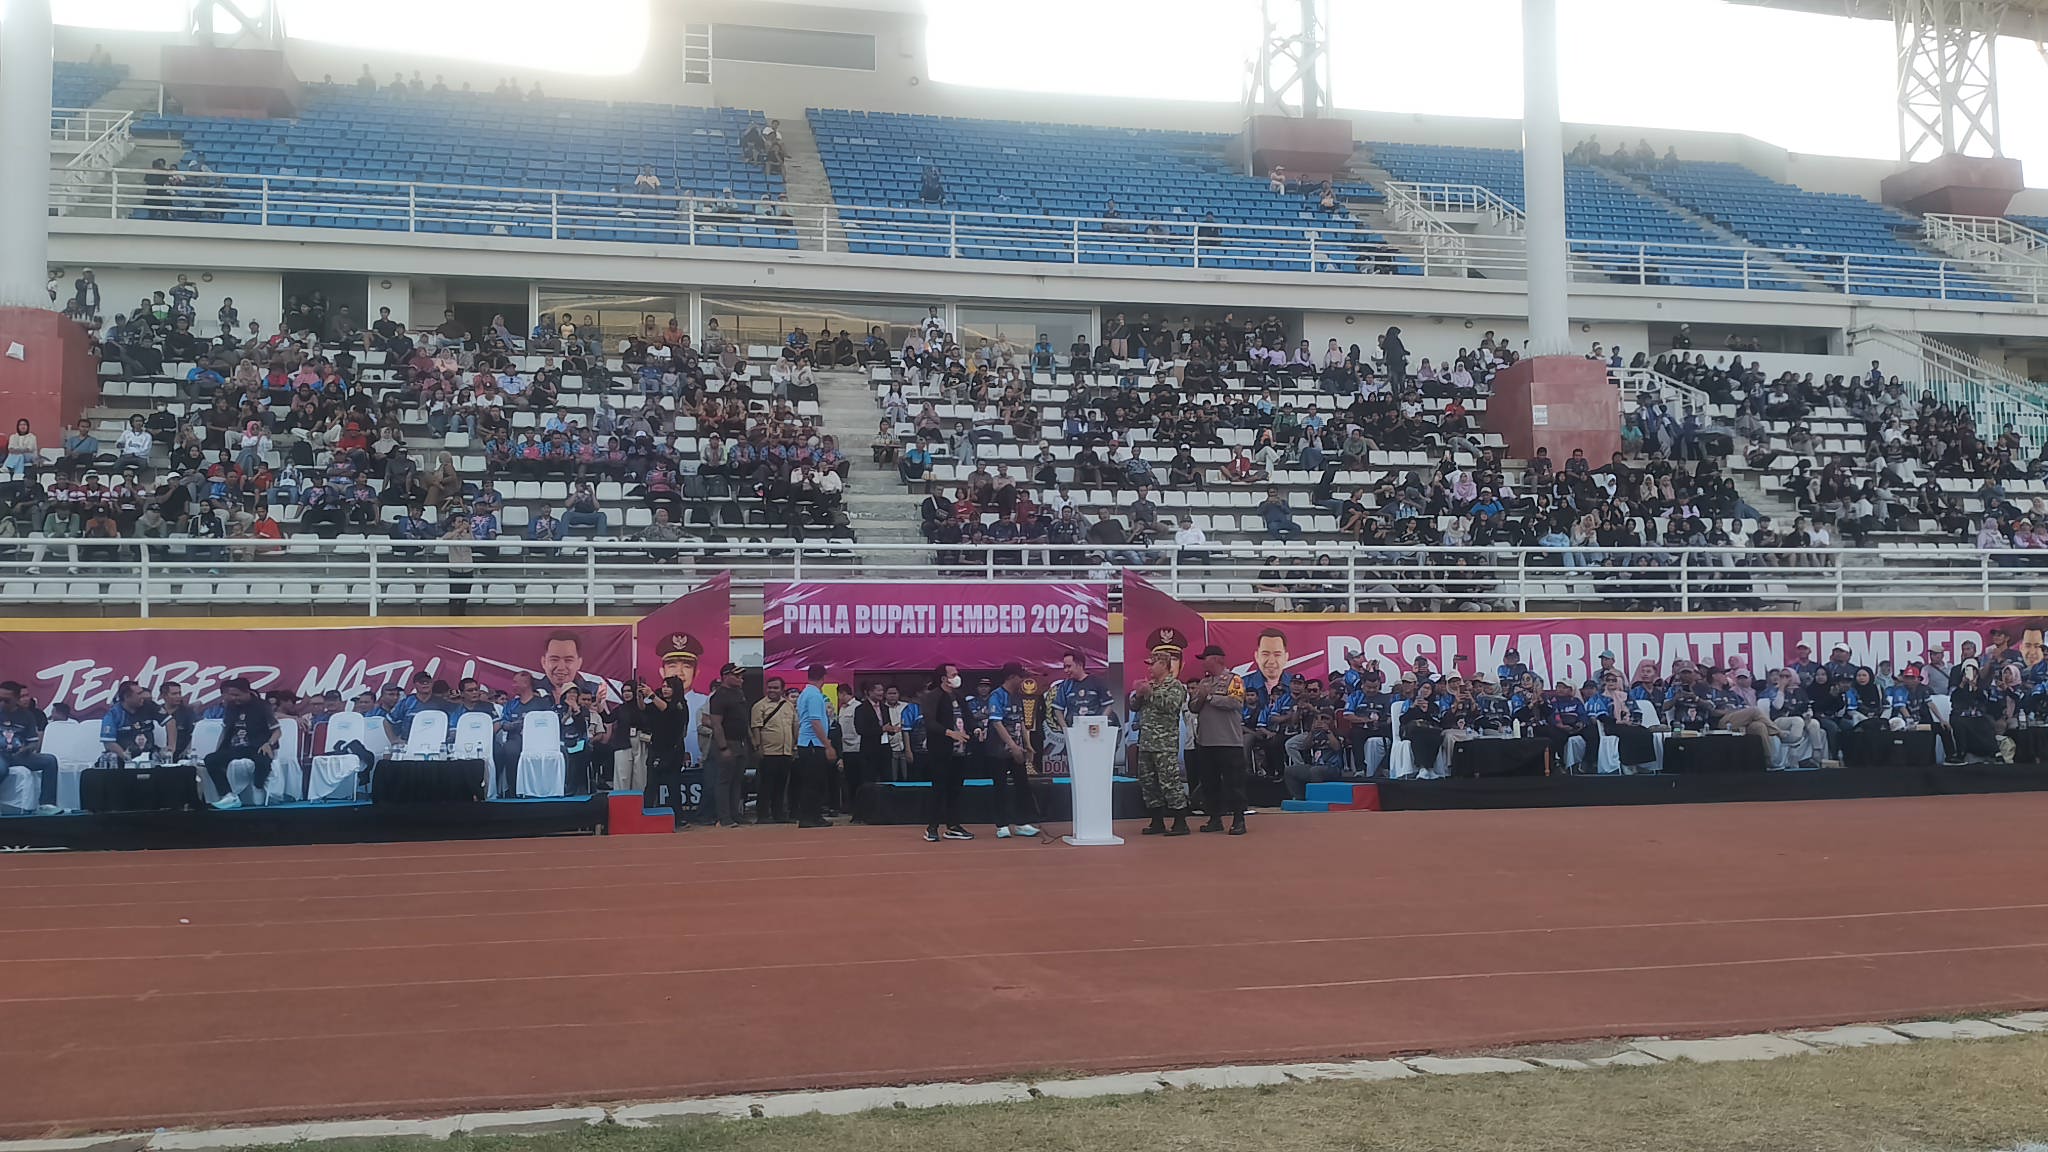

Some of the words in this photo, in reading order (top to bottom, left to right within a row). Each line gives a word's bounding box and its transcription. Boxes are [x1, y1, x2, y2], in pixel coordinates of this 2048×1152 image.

[783, 604, 850, 634] PIALA
[855, 604, 936, 634] BUPATI
[941, 604, 1026, 634] JEMBER
[1031, 604, 1089, 634] 2026
